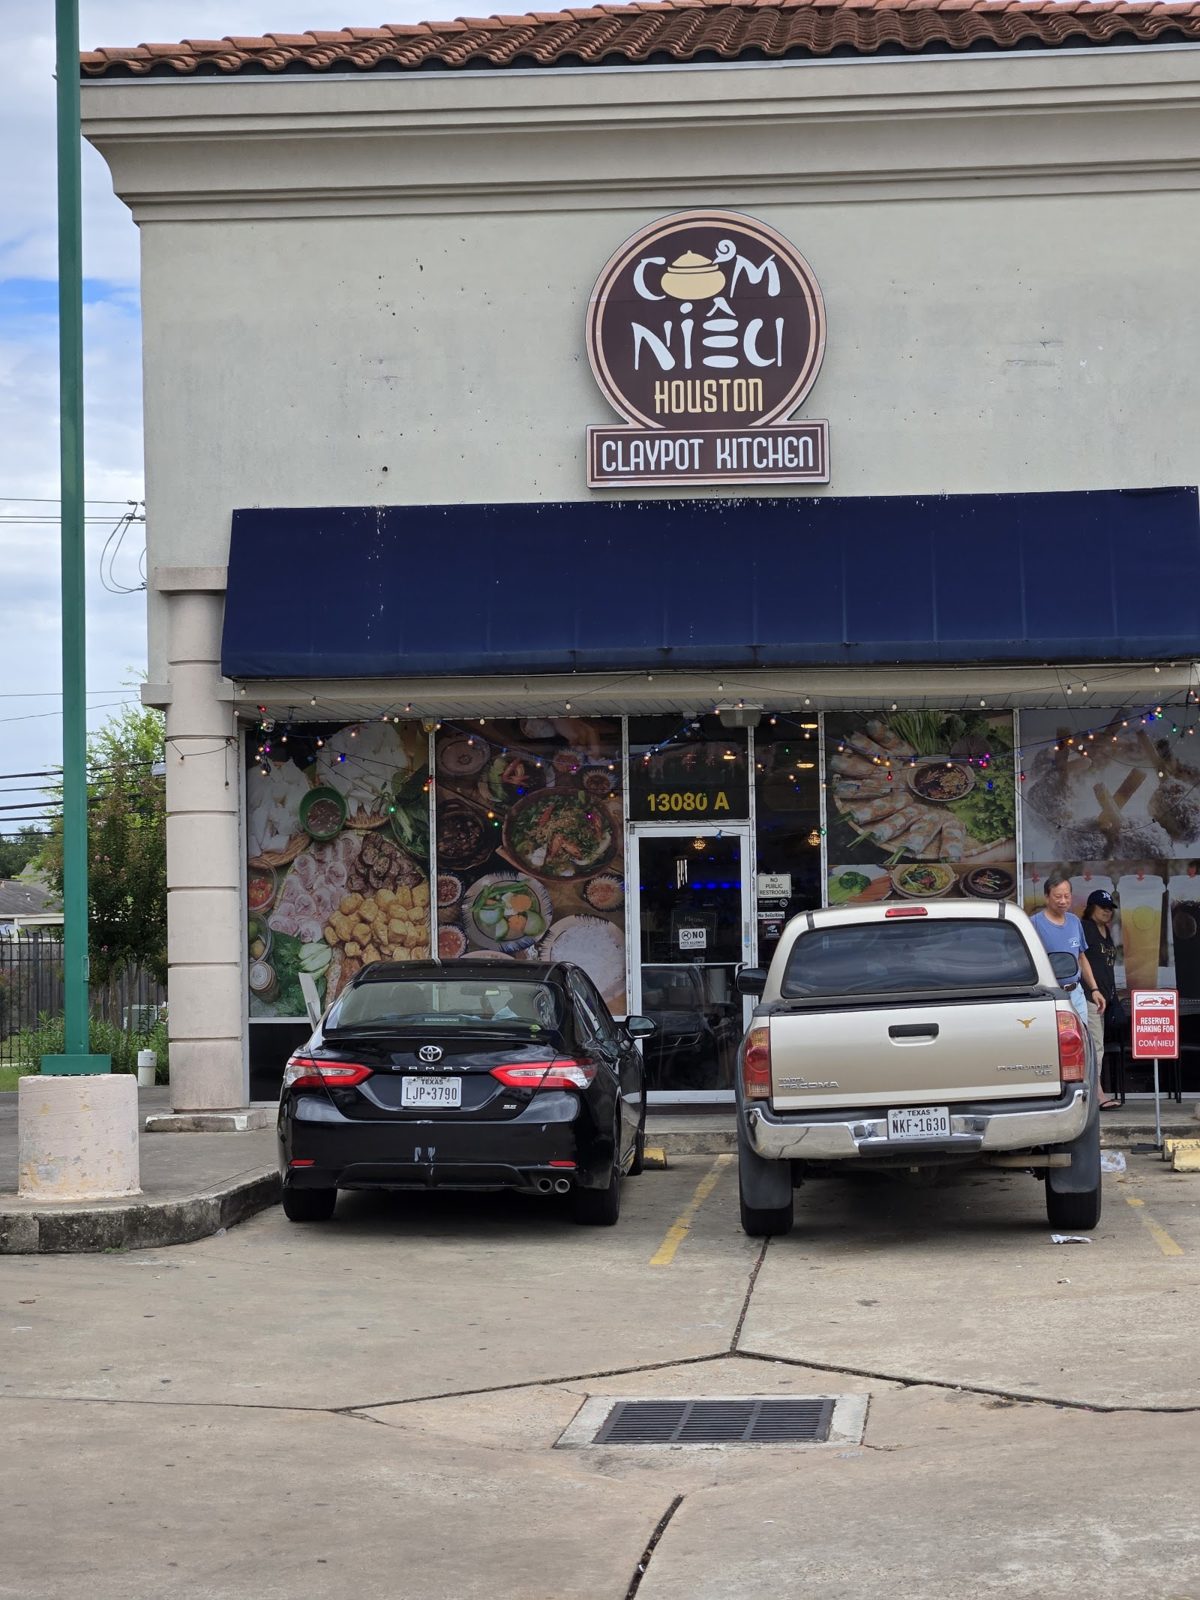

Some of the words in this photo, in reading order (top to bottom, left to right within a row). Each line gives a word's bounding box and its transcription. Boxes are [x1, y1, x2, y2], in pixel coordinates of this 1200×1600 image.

[655, 378, 763, 414] HOUSTON
[602, 439, 704, 471] CLAYPOT
[716, 436, 814, 469] KITCHEN
[647, 792, 708, 812] 13080
[714, 791, 730, 810] A
[692, 931, 704, 939] NO
[1140, 1017, 1170, 1025] RESERVED
[1136, 1025, 1161, 1033] PARKING
[1162, 1025, 1175, 1033] FOR
[1138, 1039, 1156, 1047] COM
[1157, 1039, 1175, 1047] NIEU
[431, 1087, 457, 1101] 3790
[907, 1109, 931, 1117] TEXAS
[892, 1119, 912, 1134] NKF
[919, 1117, 946, 1132] 1630
